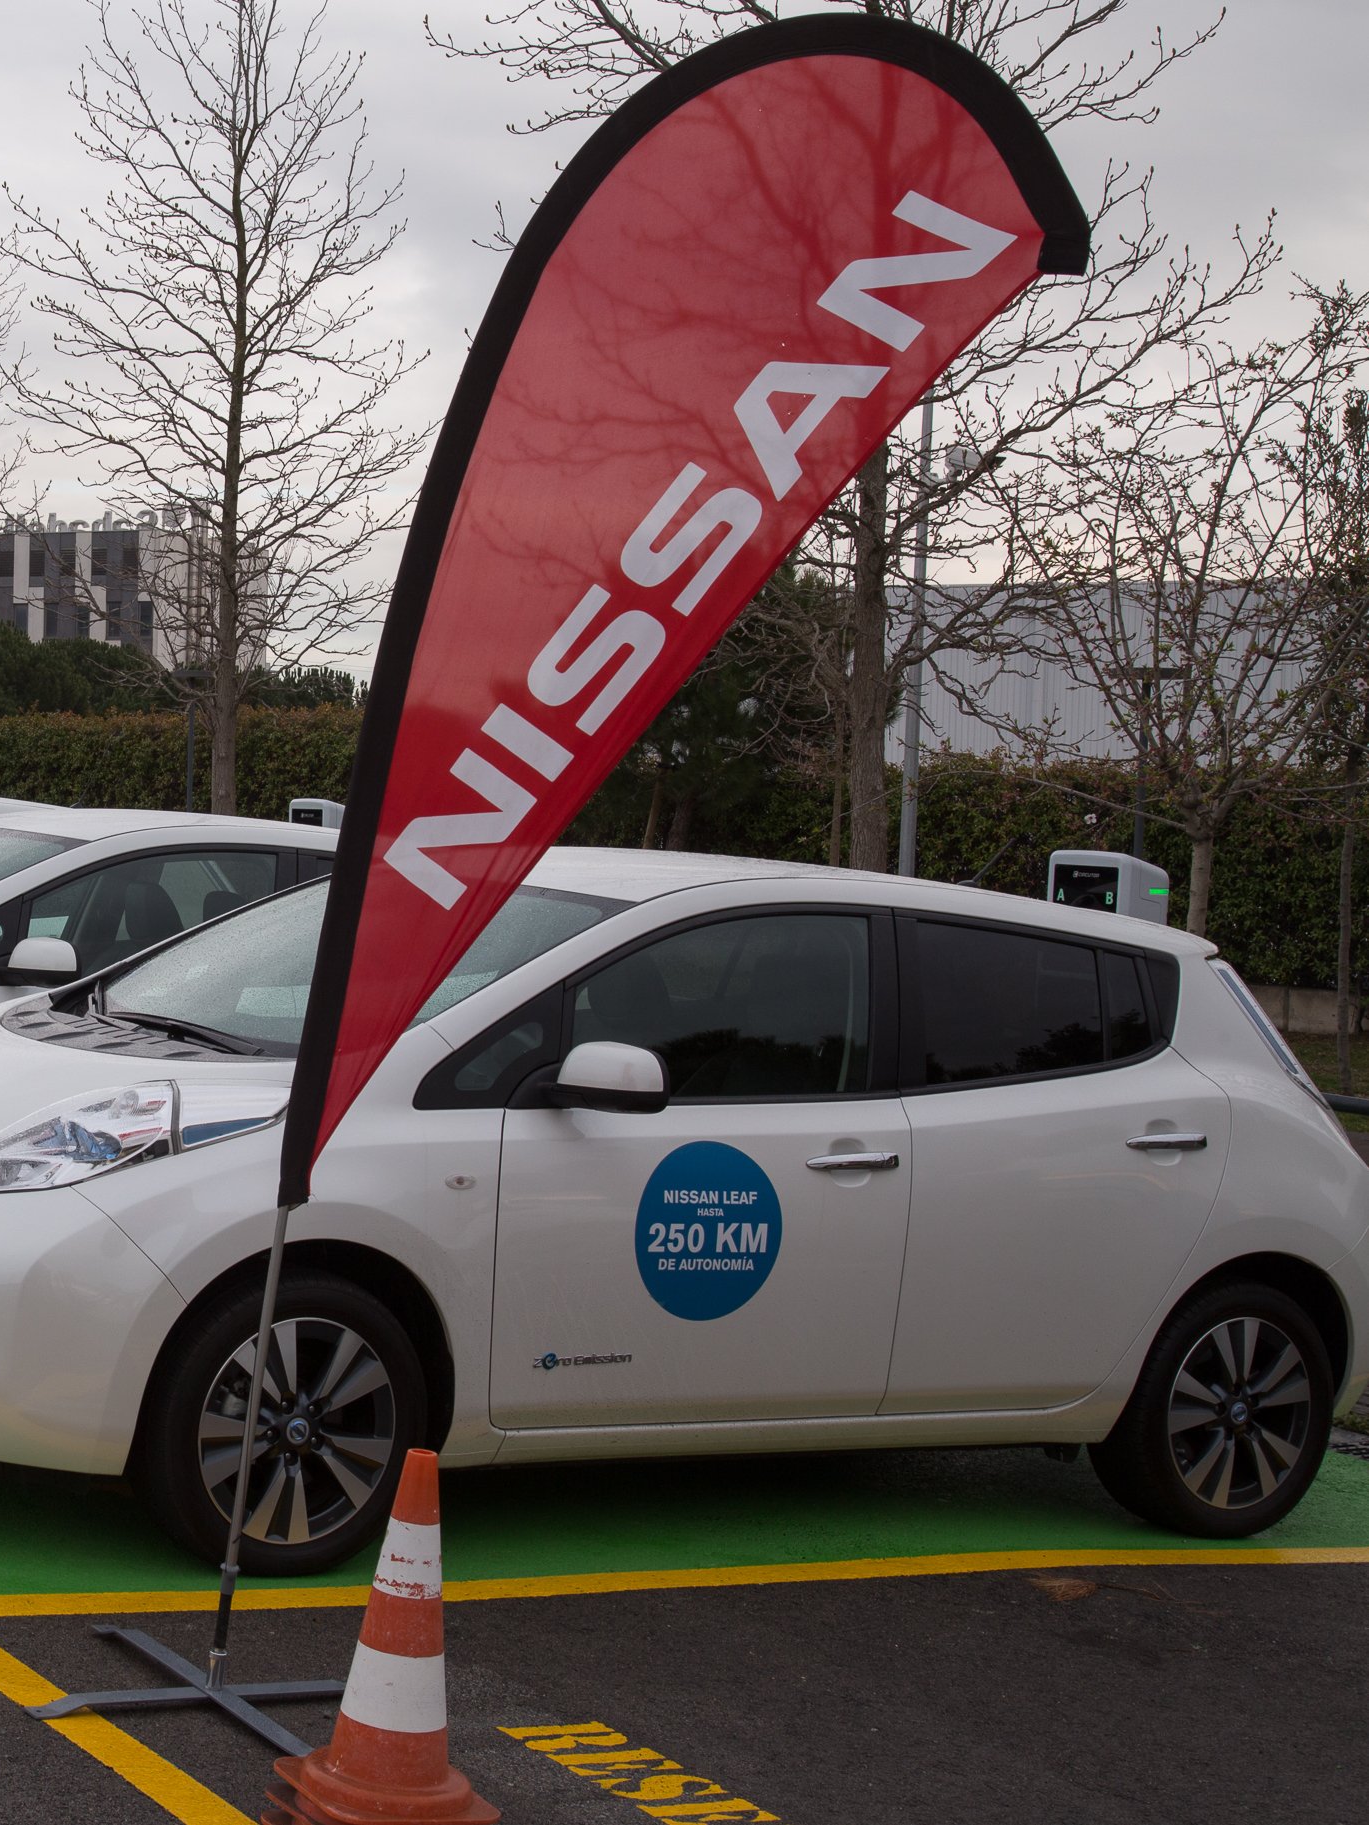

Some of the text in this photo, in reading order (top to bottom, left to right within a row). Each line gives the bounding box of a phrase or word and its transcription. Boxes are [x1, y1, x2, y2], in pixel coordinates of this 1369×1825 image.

[384, 190, 1018, 910] NISSAN
[1057, 888, 1065, 901] A
[1105, 892, 1114, 905] B
[664, 1190, 758, 1204] NISSAN LEAF
[697, 1208, 724, 1216] HASTA
[647, 1222, 769, 1253] 250 KM
[658, 1256, 754, 1271] DE AUTONOMÍA
[496, 1721, 781, 1825] RESE
